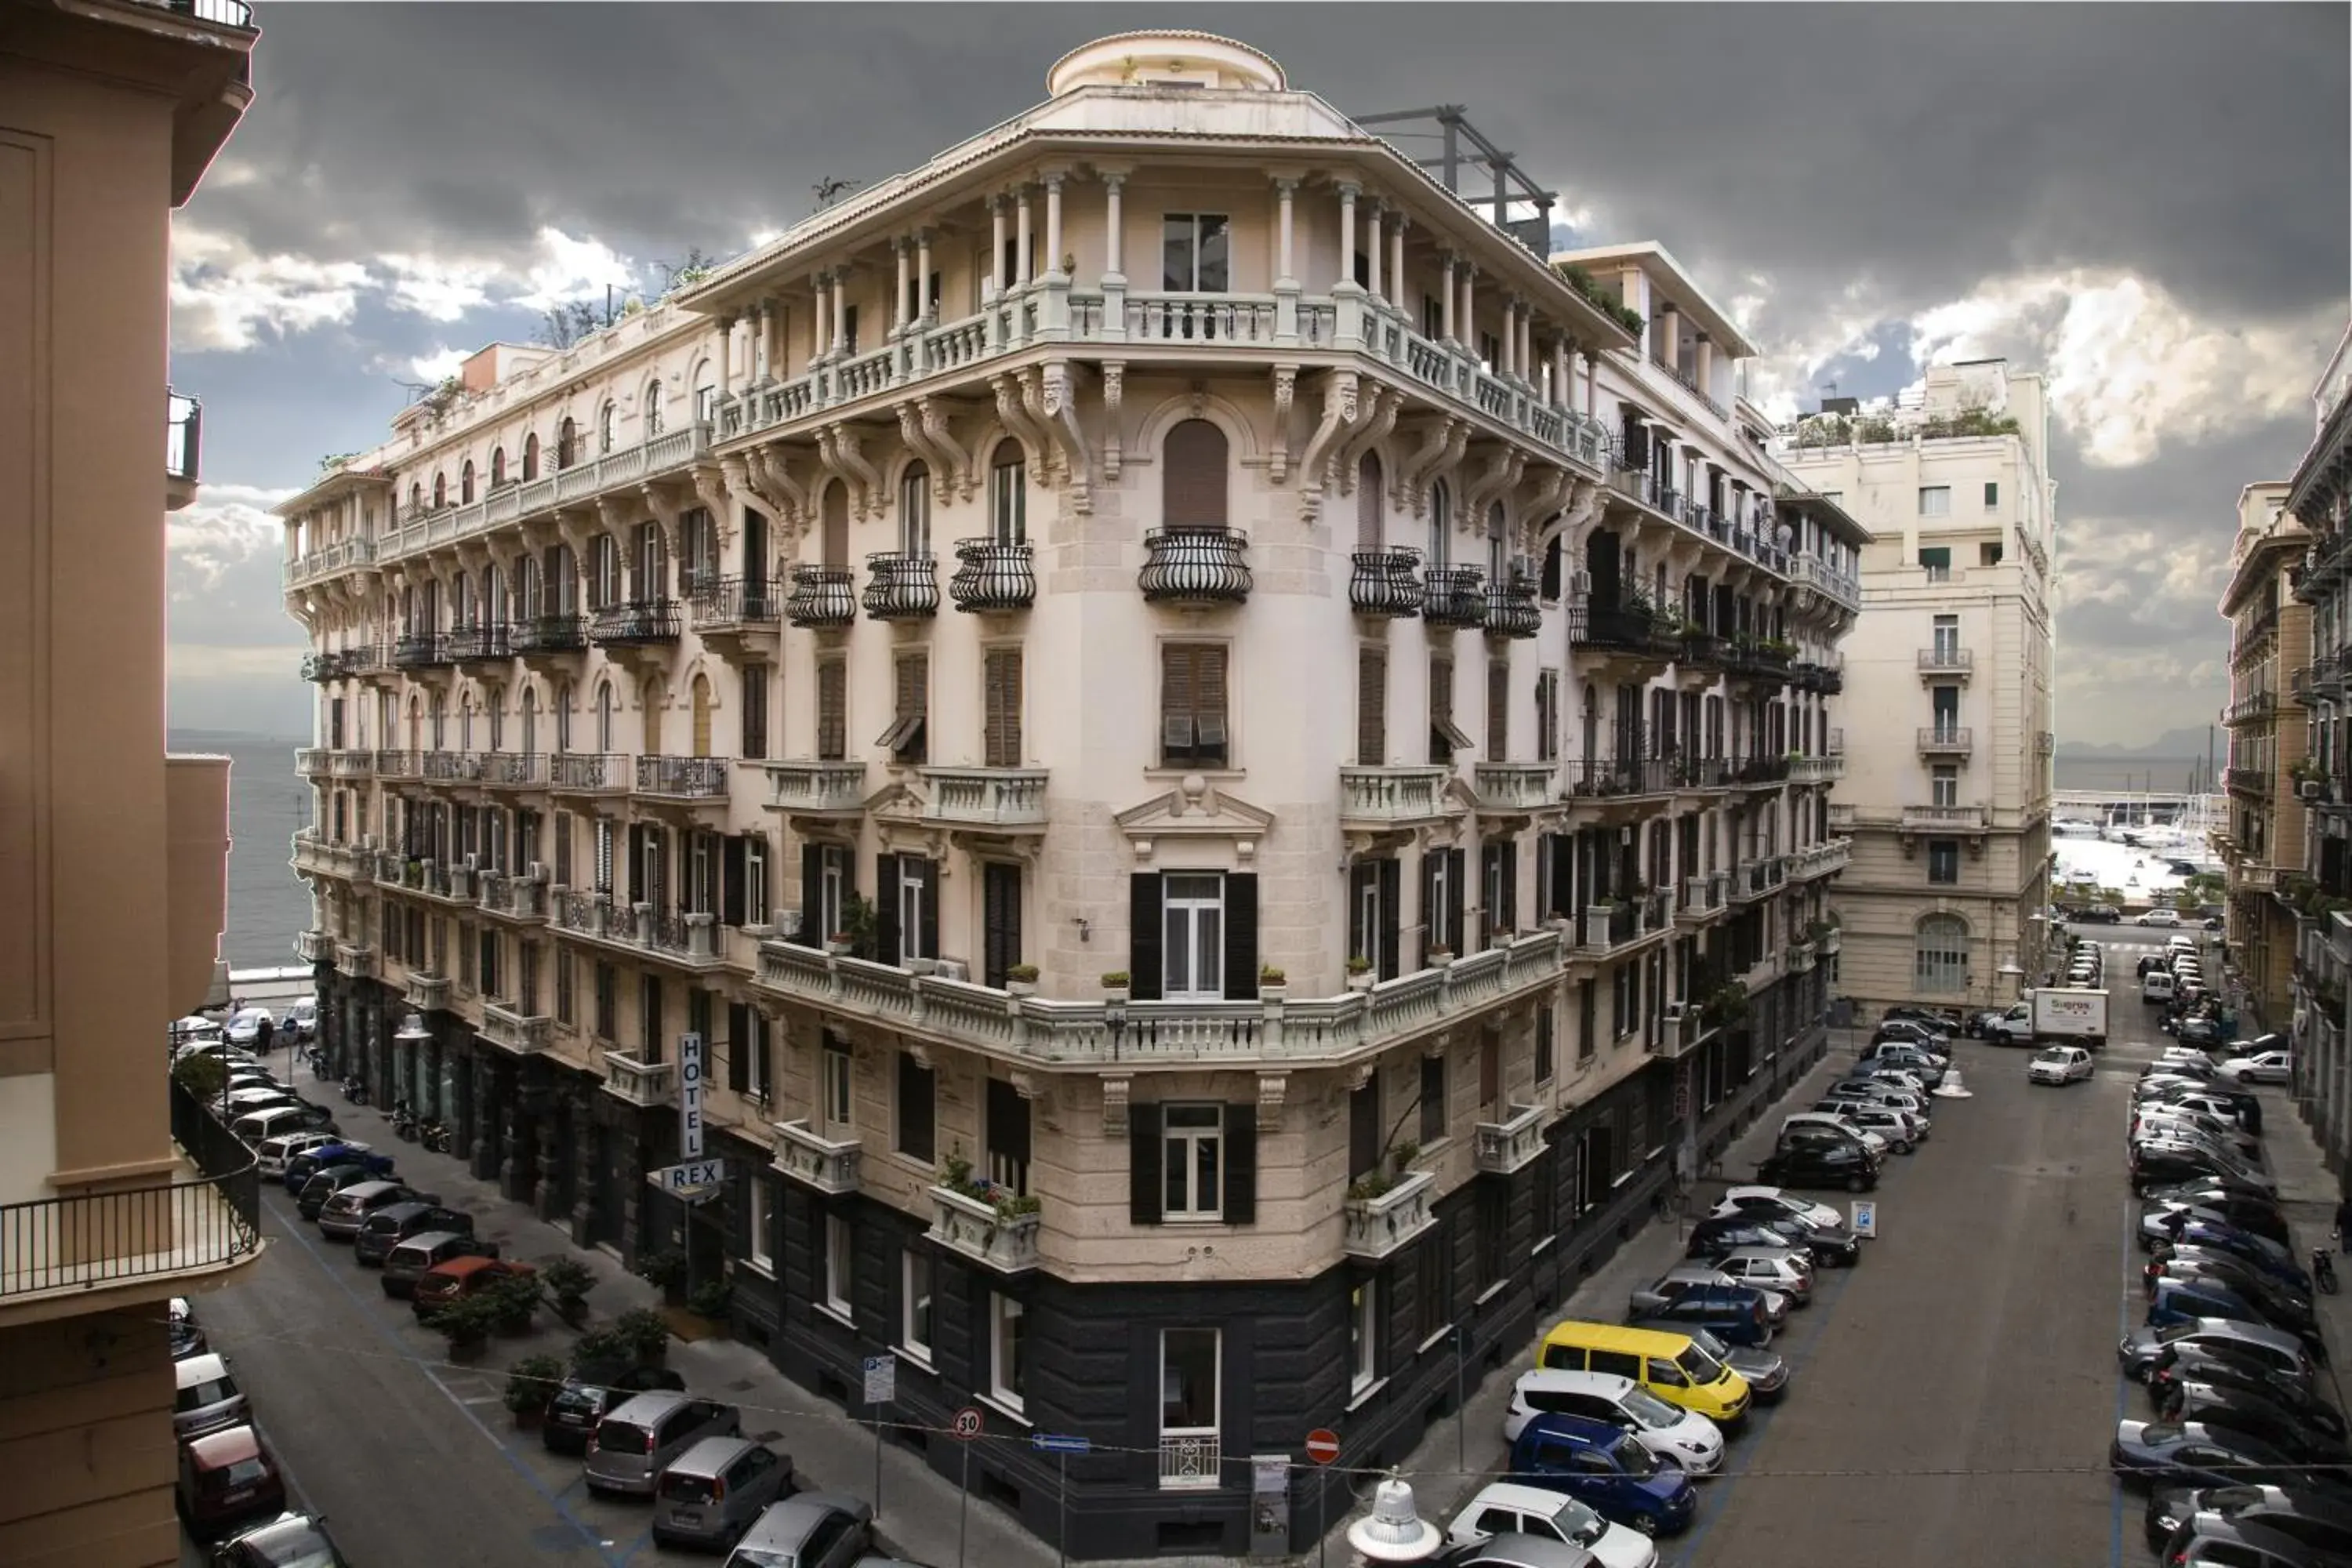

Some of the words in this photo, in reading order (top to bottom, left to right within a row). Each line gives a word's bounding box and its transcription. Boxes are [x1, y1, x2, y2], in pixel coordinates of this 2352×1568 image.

[684, 1040, 699, 1152] HOTEL
[673, 1164, 716, 1188] REX
[960, 1416, 976, 1431] 30
